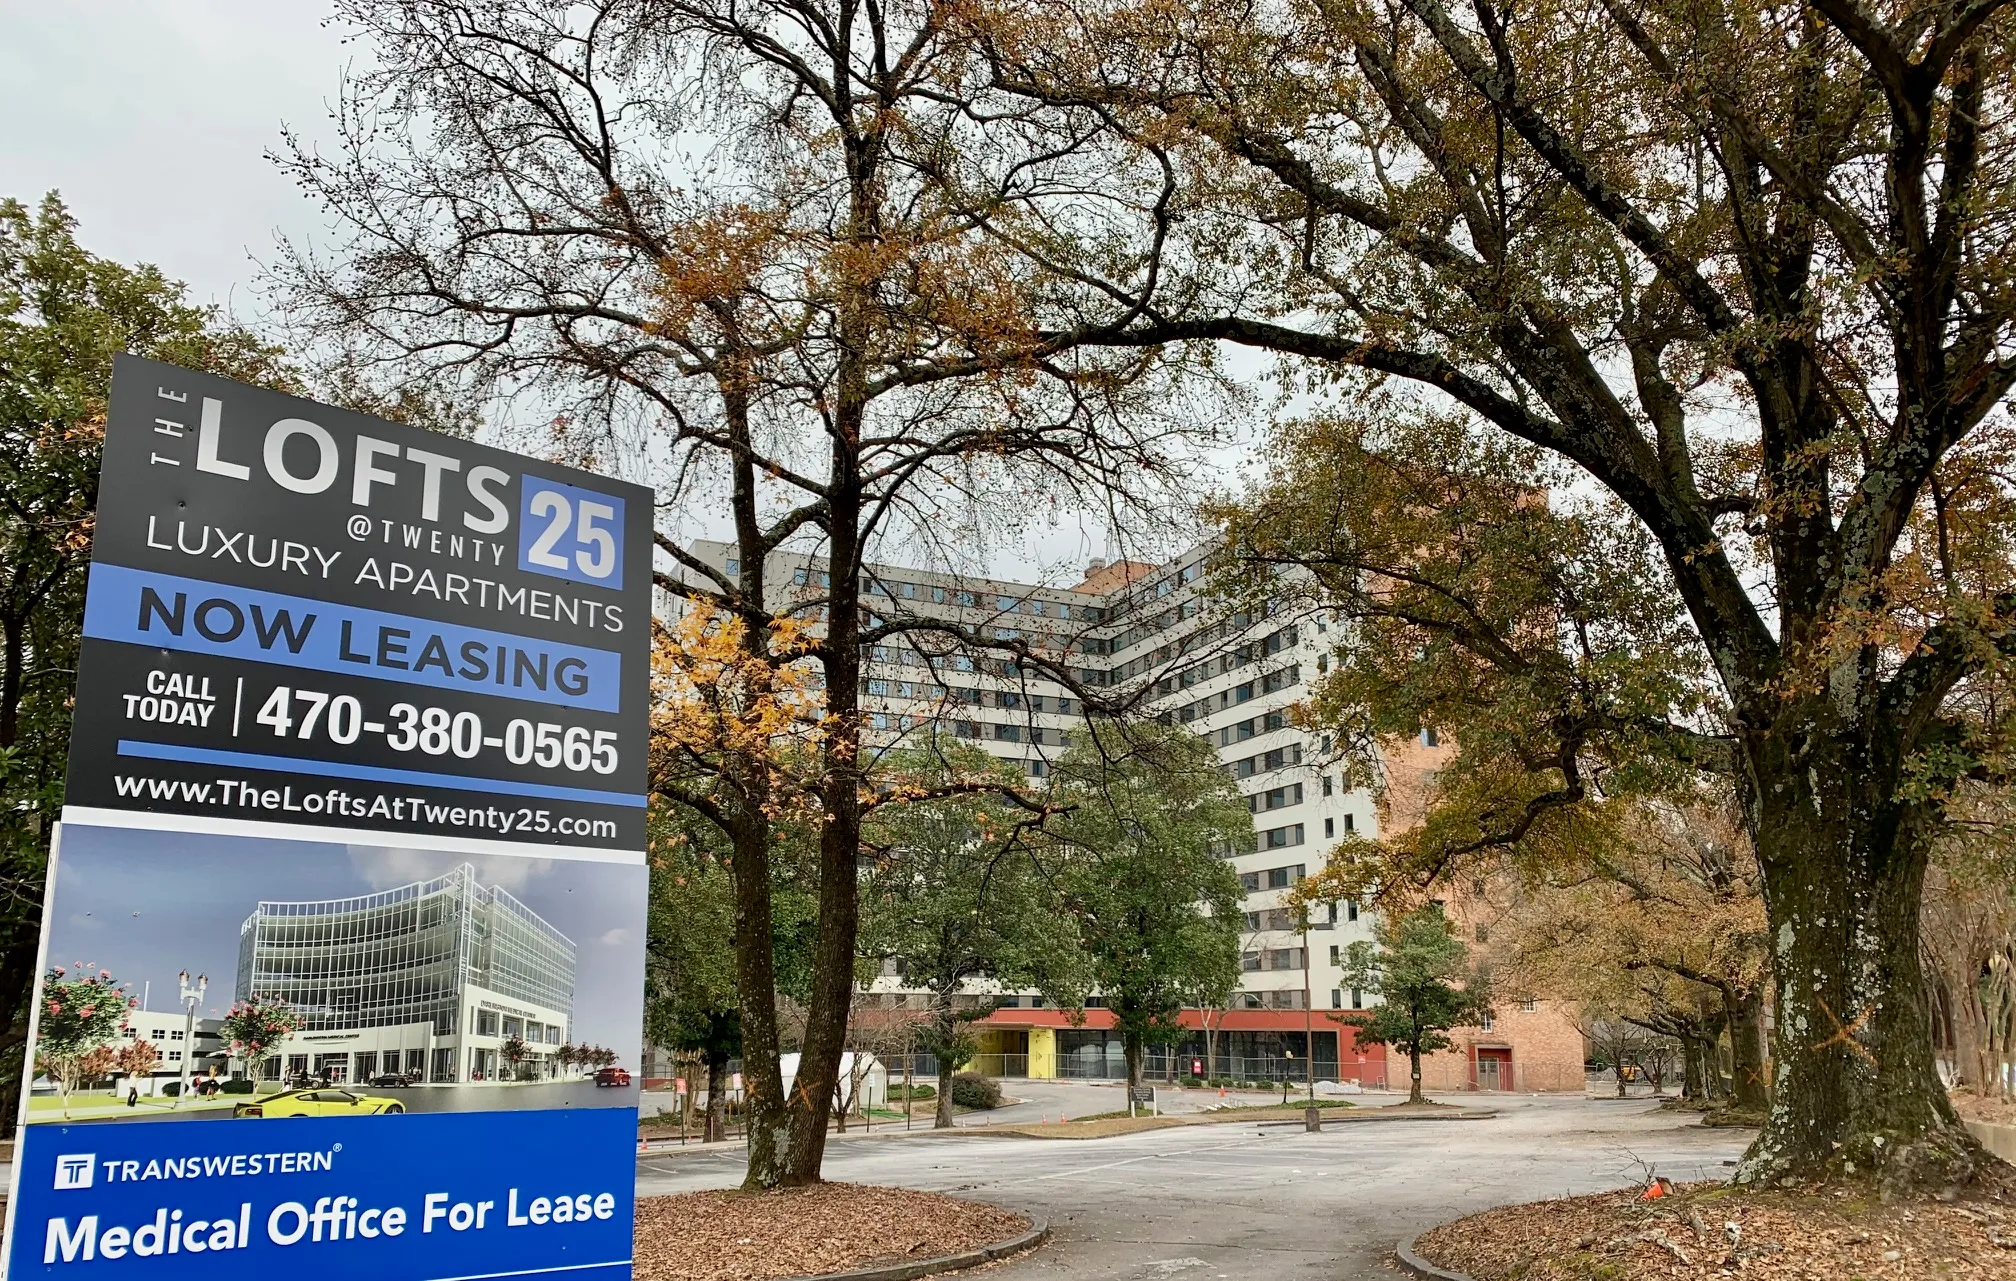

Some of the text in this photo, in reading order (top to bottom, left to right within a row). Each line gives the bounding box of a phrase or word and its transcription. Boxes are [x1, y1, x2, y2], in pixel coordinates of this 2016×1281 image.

[151, 386, 187, 466] THE
[196, 396, 511, 534] LOFTS
[147, 515, 624, 633] LUXURY APARTMENTS
[527, 490, 615, 579] 25
[137, 586, 589, 696] NOW LEASING
[122, 694, 215, 728] TODAY
[146, 670, 216, 702] CALL
[256, 685, 618, 775] 470-380-0565
[113, 775, 617, 838] www.TheLoftsAtTwenty25.com
[43, 1188, 615, 1264] Medical Office For Lease
